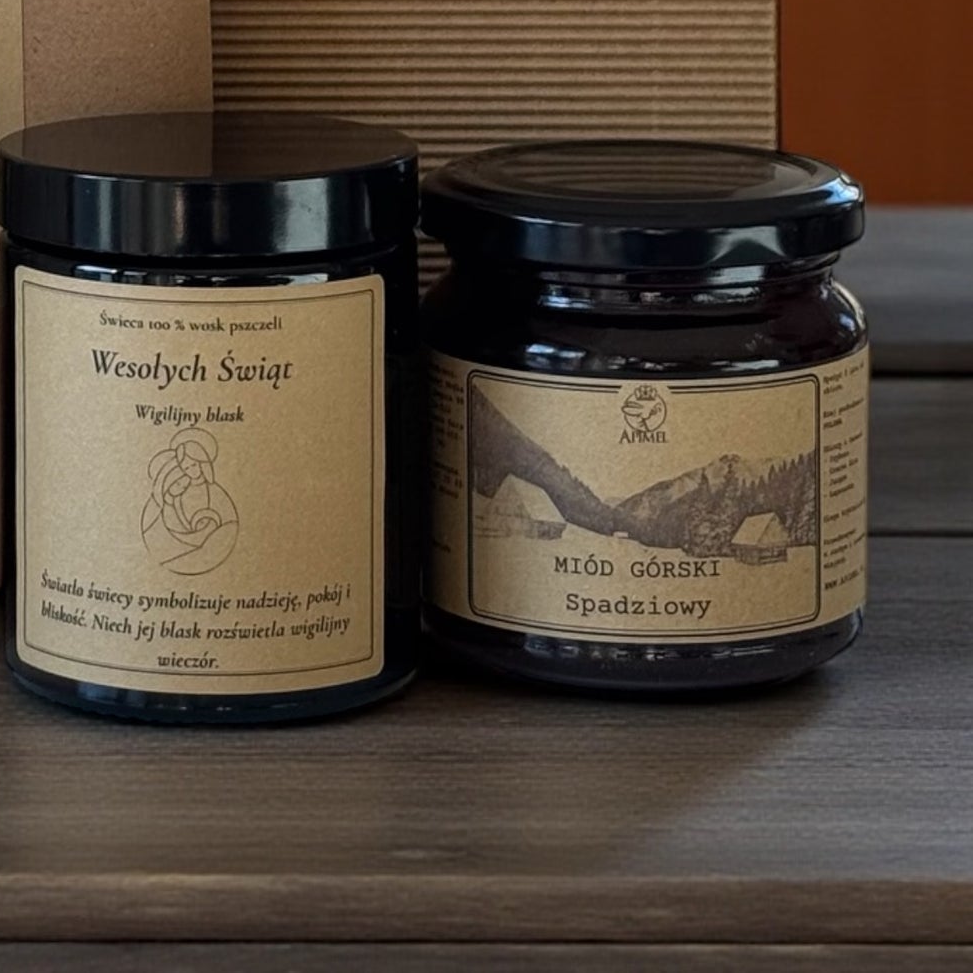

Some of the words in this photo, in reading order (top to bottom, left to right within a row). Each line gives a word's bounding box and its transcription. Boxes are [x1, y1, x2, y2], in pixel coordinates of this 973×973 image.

[189, 317, 226, 332] wosk
[229, 315, 282, 336] pszczeli
[91, 349, 207, 390] Wesołych
[217, 350, 294, 390] Świąt
[135, 404, 201, 427] Wigilijny
[206, 405, 244, 423] blask
[554, 553, 614, 576] MIÓD
[631, 556, 721, 578] GÓRSKI
[41, 569, 84, 597] Światło
[87, 581, 133, 608] świecy
[138, 591, 230, 614] symbolizuje
[236, 590, 302, 612] nadzieję,
[306, 584, 342, 611] pokój
[347, 584, 351, 599] i
[566, 593, 711, 619] Spadziowy
[41, 600, 87, 627] bliskość.
[92, 613, 132, 634] Niech
[135, 621, 154, 642] jej
[160, 619, 201, 638] blask
[207, 620, 285, 640] rozświetla
[291, 614, 350, 639] wigilijny
[158, 650, 219, 669] wieczór.
